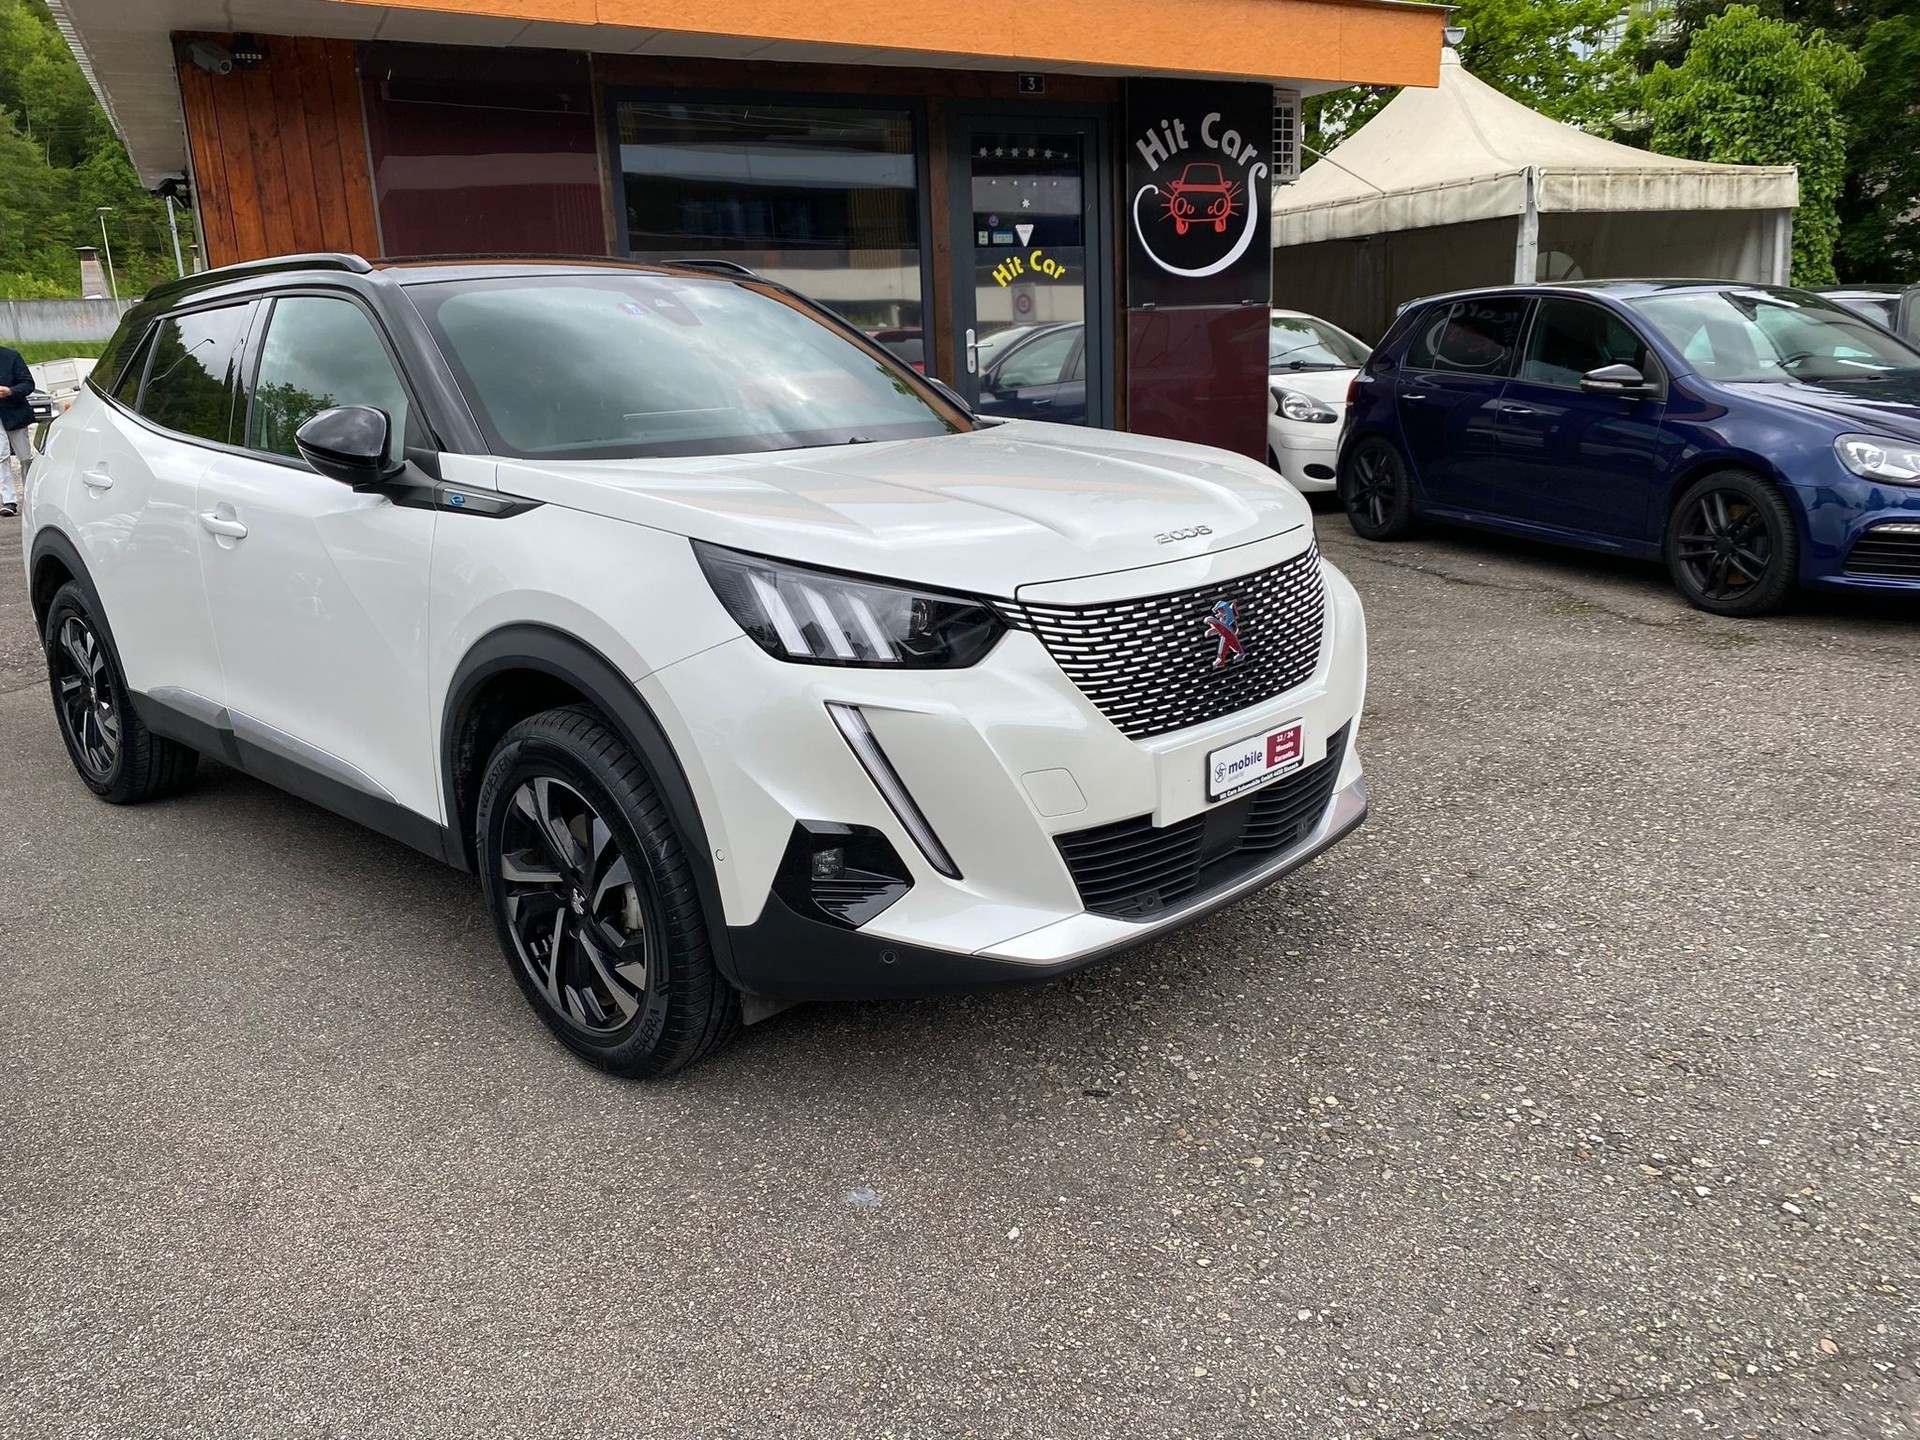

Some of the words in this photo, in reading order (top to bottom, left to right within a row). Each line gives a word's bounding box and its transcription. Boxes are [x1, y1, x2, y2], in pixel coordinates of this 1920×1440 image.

[1027, 76, 1036, 90] 3
[1135, 118, 1189, 172] Hit
[992, 255, 1025, 288] Hit
[1029, 249, 1066, 280] Car
[1153, 524, 1213, 545] 2008
[1228, 750, 1263, 774] mobile
